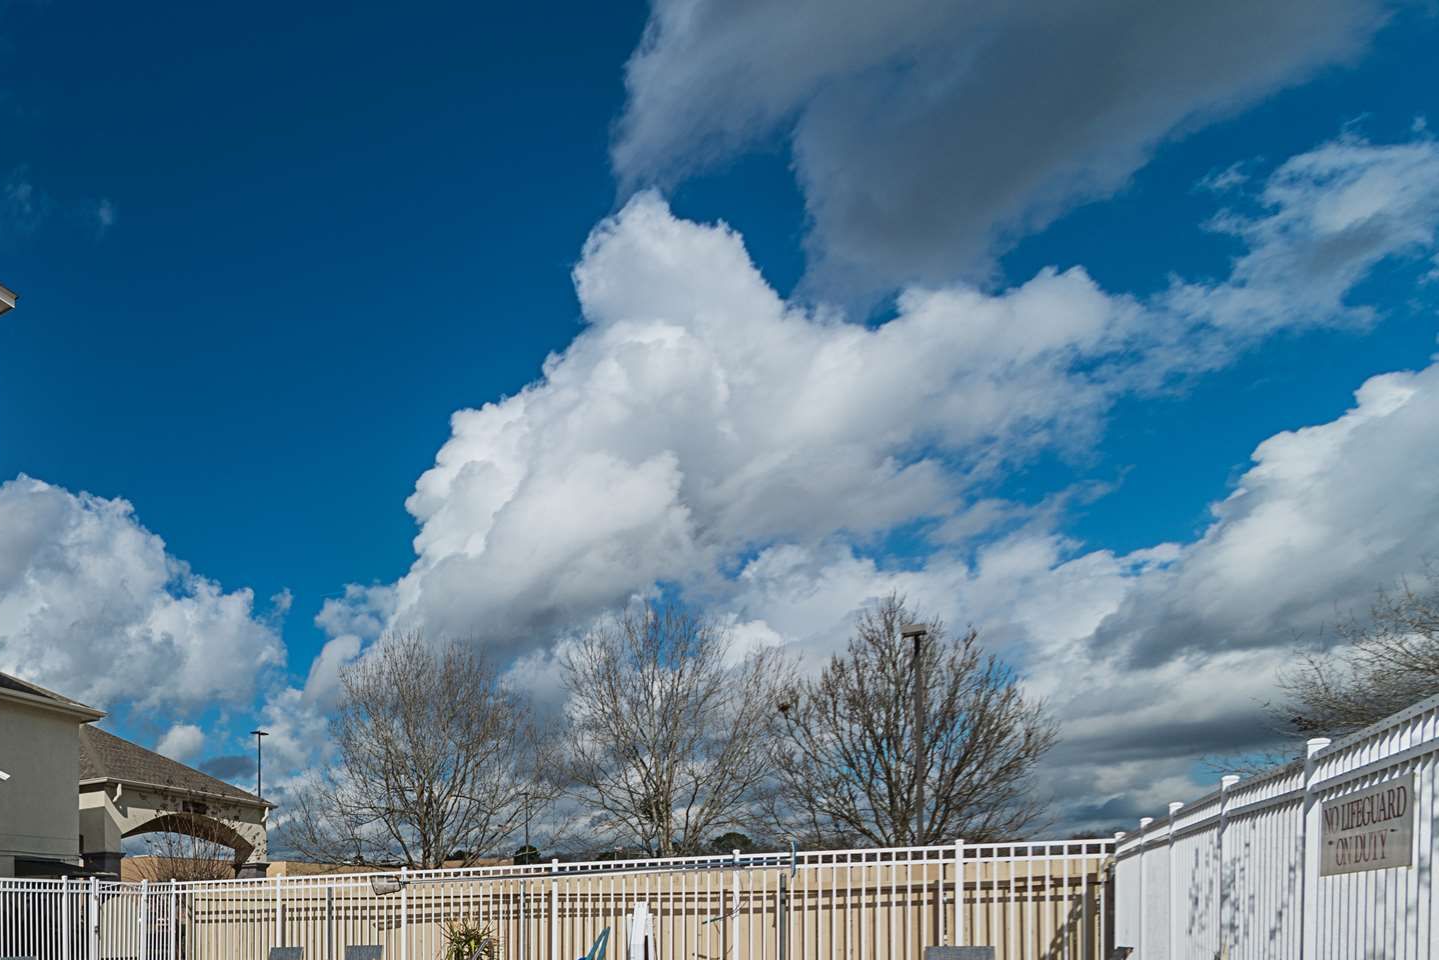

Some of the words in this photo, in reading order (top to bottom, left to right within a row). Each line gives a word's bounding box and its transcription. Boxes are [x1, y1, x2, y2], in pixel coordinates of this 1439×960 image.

[1324, 805, 1339, 834] NO
[1341, 785, 1407, 831] LIFEGUARD
[1336, 836, 1352, 866] ON
[1355, 829, 1388, 863] DUTY
